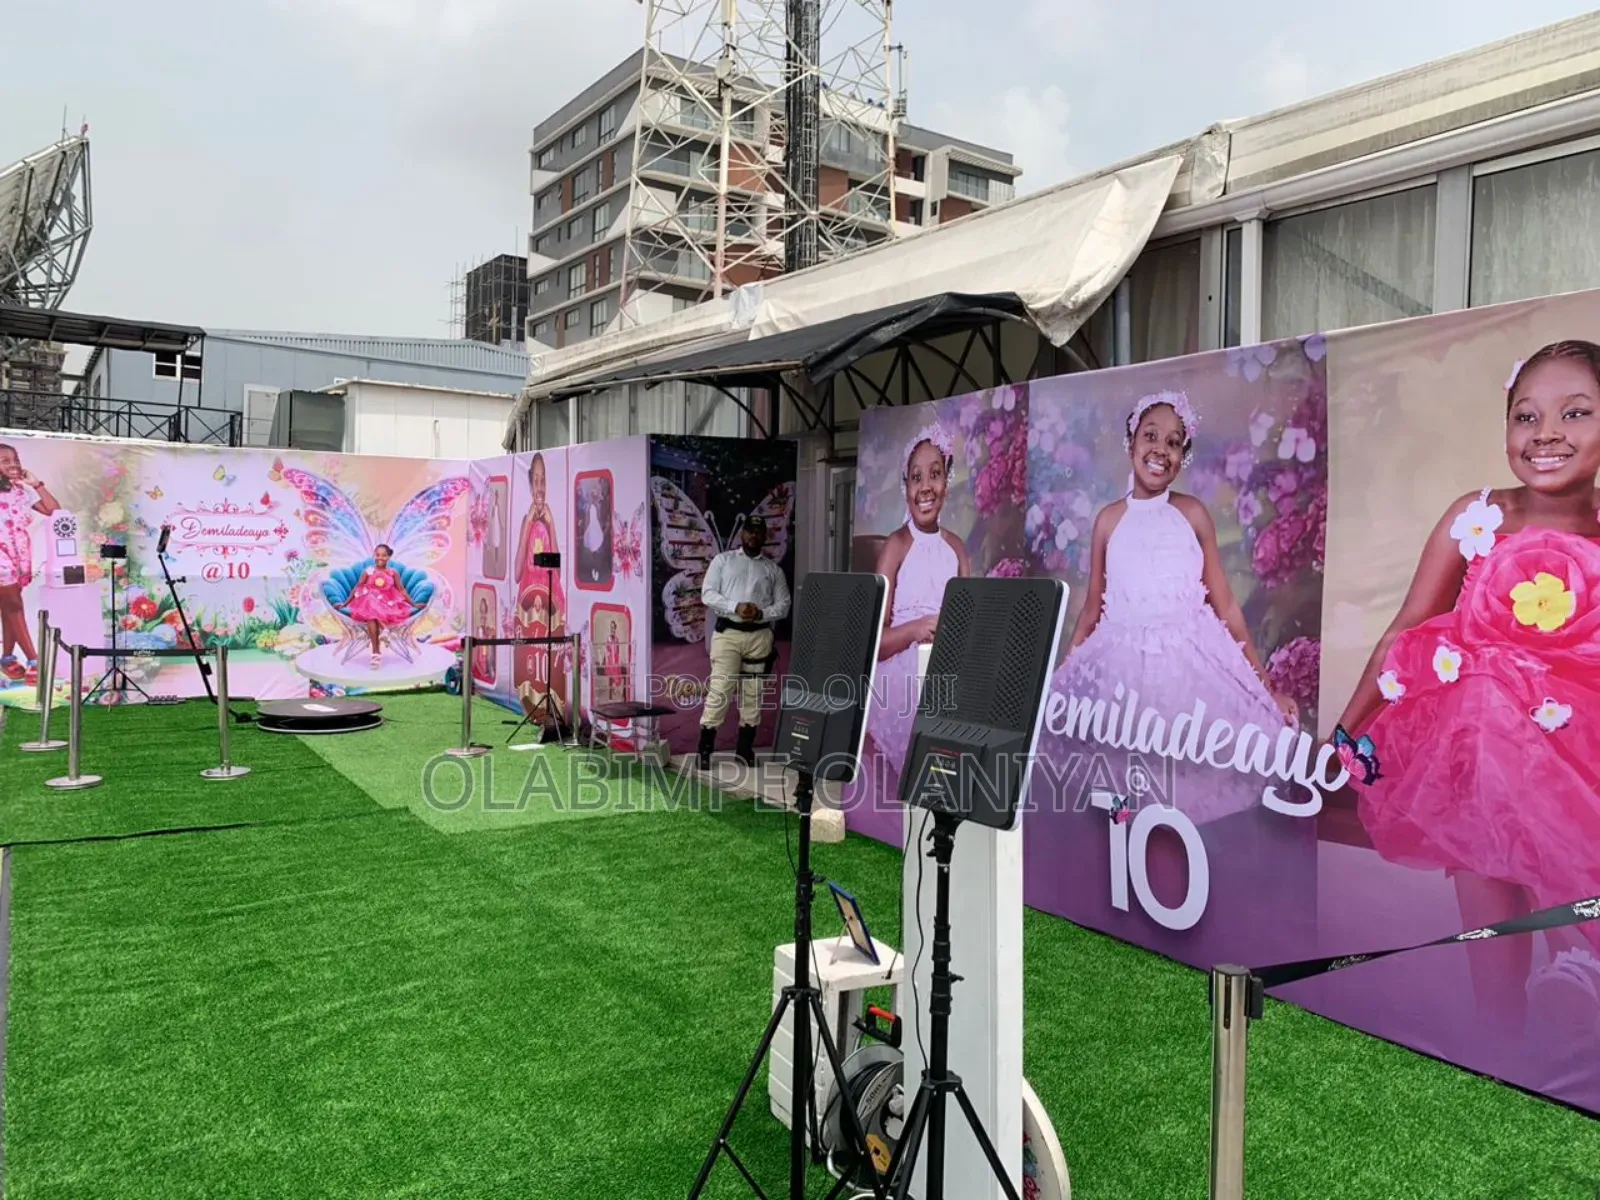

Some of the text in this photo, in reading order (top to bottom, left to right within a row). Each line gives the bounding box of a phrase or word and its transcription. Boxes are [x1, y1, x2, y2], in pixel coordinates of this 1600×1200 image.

[180, 516, 270, 540] Demiladeayo
[1044, 681, 1350, 817] emiladeayo
[1091, 788, 1210, 931] 10
